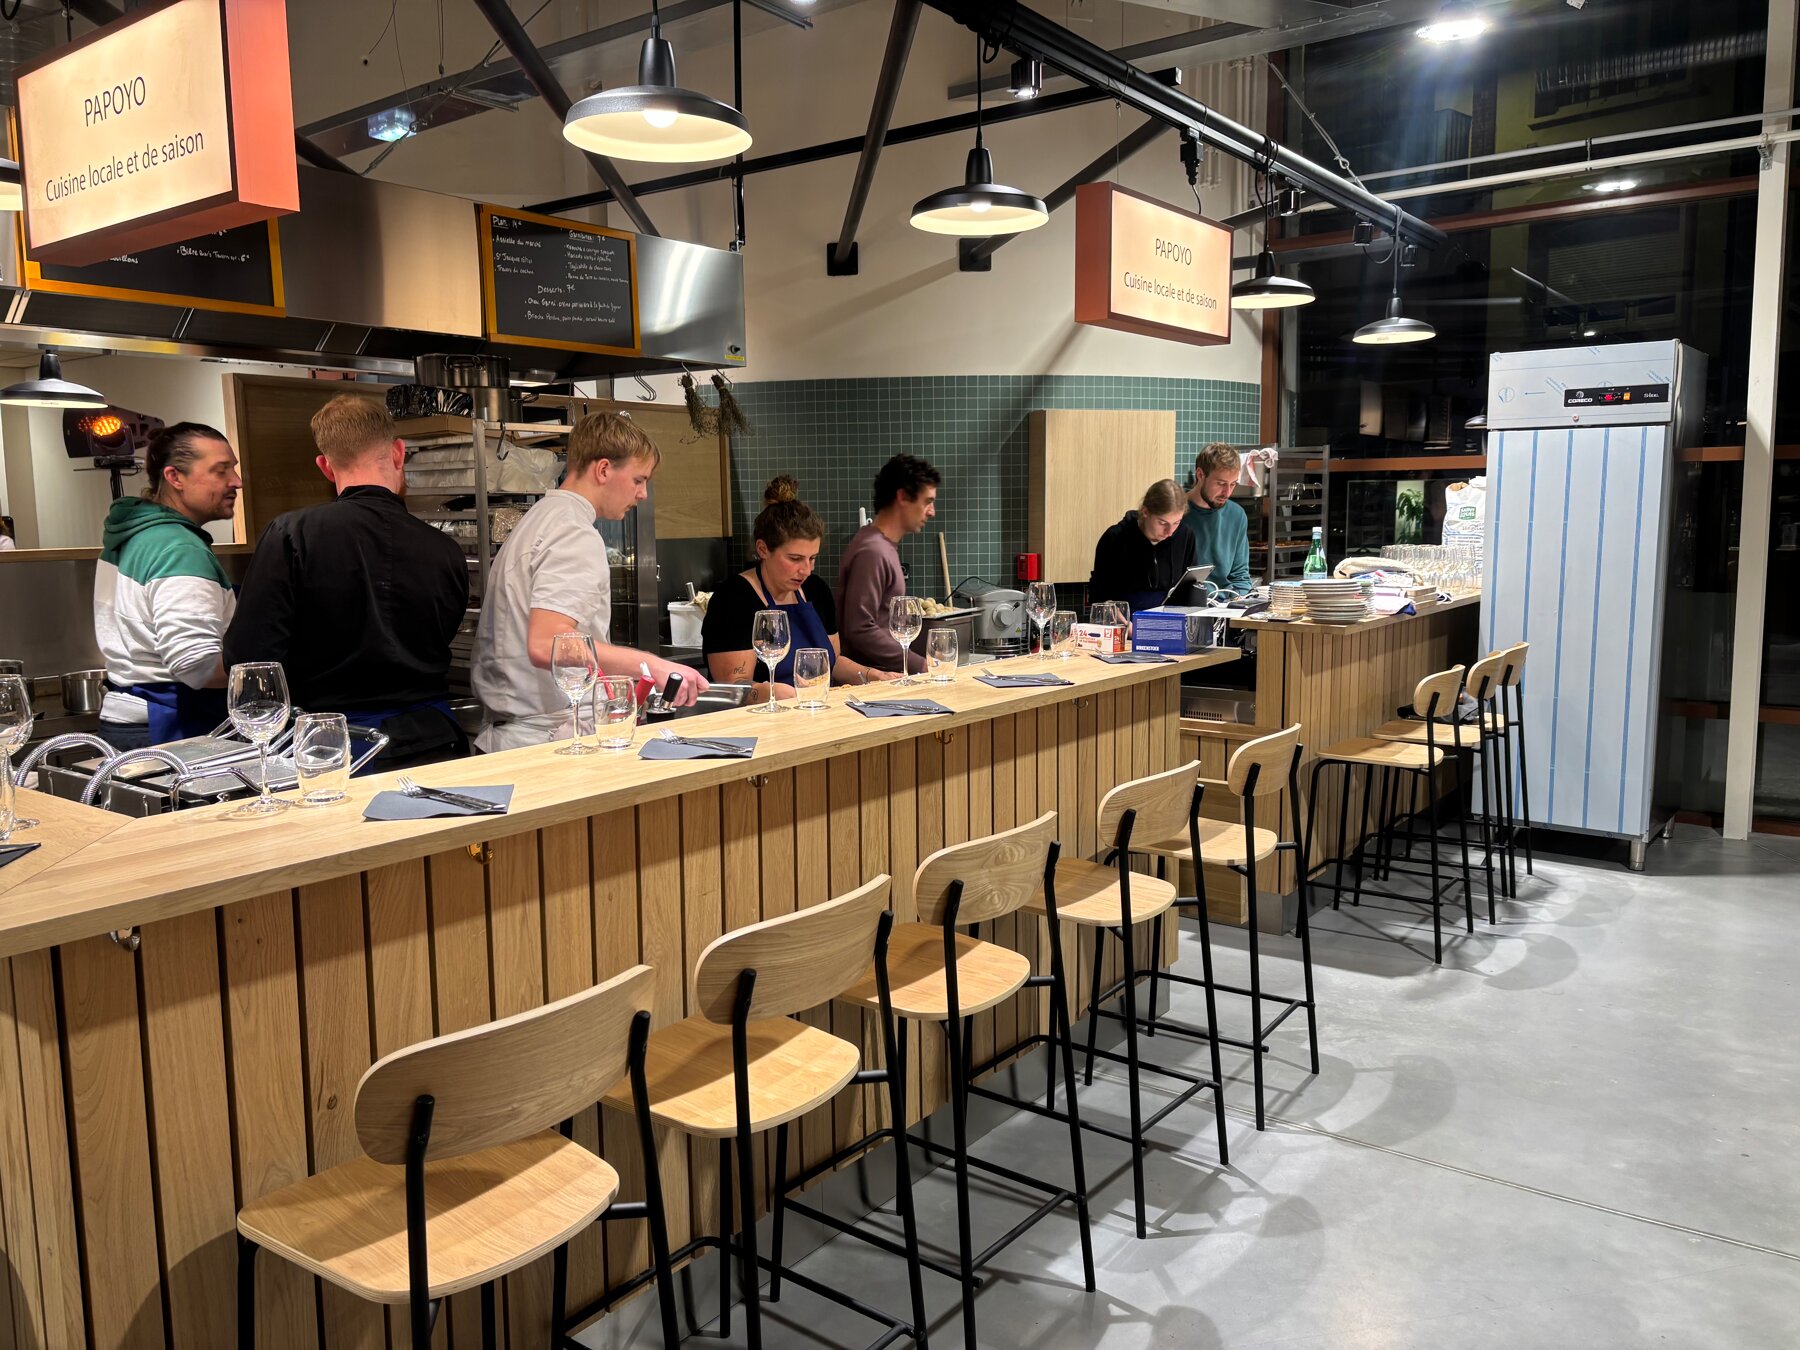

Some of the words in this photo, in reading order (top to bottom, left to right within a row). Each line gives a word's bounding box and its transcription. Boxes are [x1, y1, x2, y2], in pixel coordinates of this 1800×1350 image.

[84, 76, 146, 127] PAPOYO
[45, 172, 86, 202] Cuisine
[89, 156, 124, 188] locale
[127, 151, 139, 174] et
[142, 144, 158, 169] de
[162, 132, 204, 163] saison
[1155, 238, 1192, 266] PAPOYO
[1124, 271, 1152, 293] Cuisine
[1154, 279, 1175, 299] locale
[1177, 289, 1184, 302] et
[1186, 289, 1195, 304] de
[1196, 293, 1217, 310] saison
[1079, 629, 1088, 637] 24
